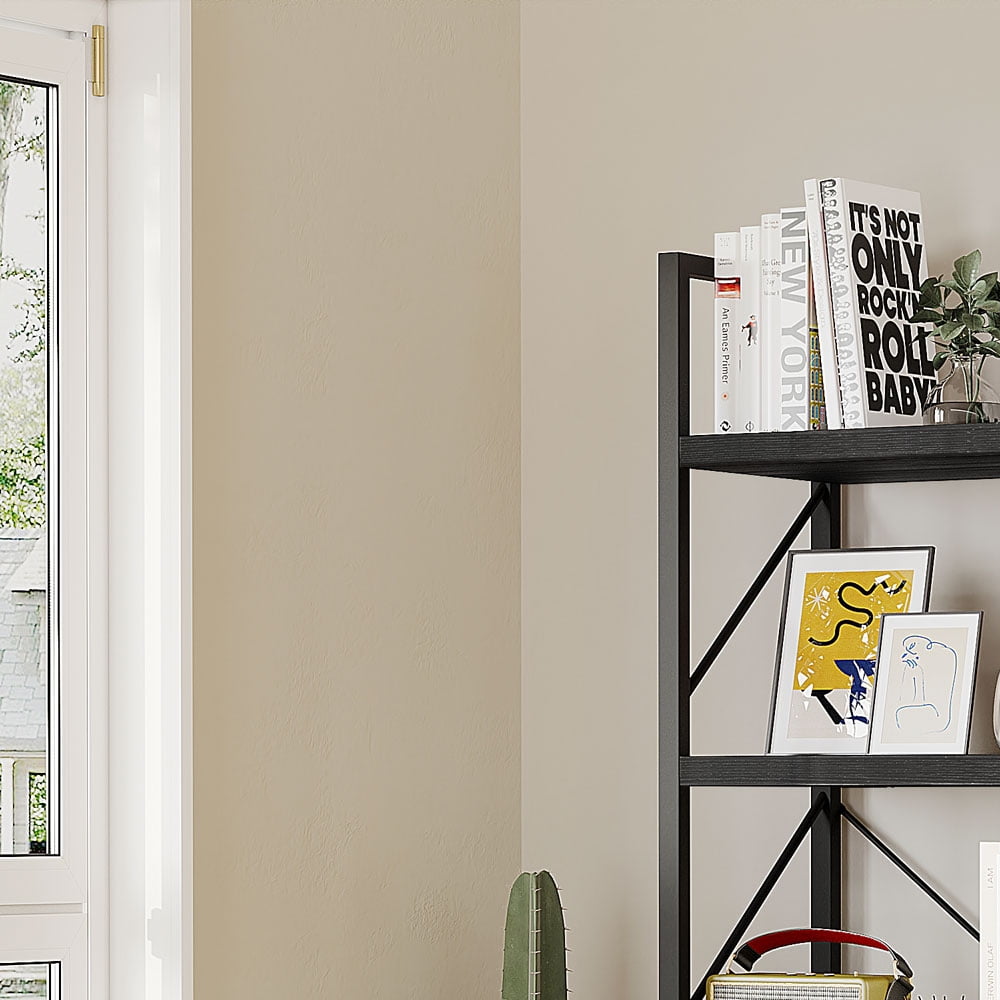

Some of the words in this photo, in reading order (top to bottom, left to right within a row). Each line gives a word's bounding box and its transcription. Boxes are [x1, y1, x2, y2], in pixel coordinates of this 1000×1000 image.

[848, 201, 882, 236] IT'S
[884, 207, 920, 243] NOT
[781, 210, 806, 304] NEW
[851, 232, 923, 292] ONLY
[721, 307, 730, 320] An
[721, 322, 730, 352] Eames
[860, 317, 936, 377] ROLL
[721, 354, 730, 384] Primer
[781, 317, 806, 430] YORK
[986, 867, 994, 885] AM
